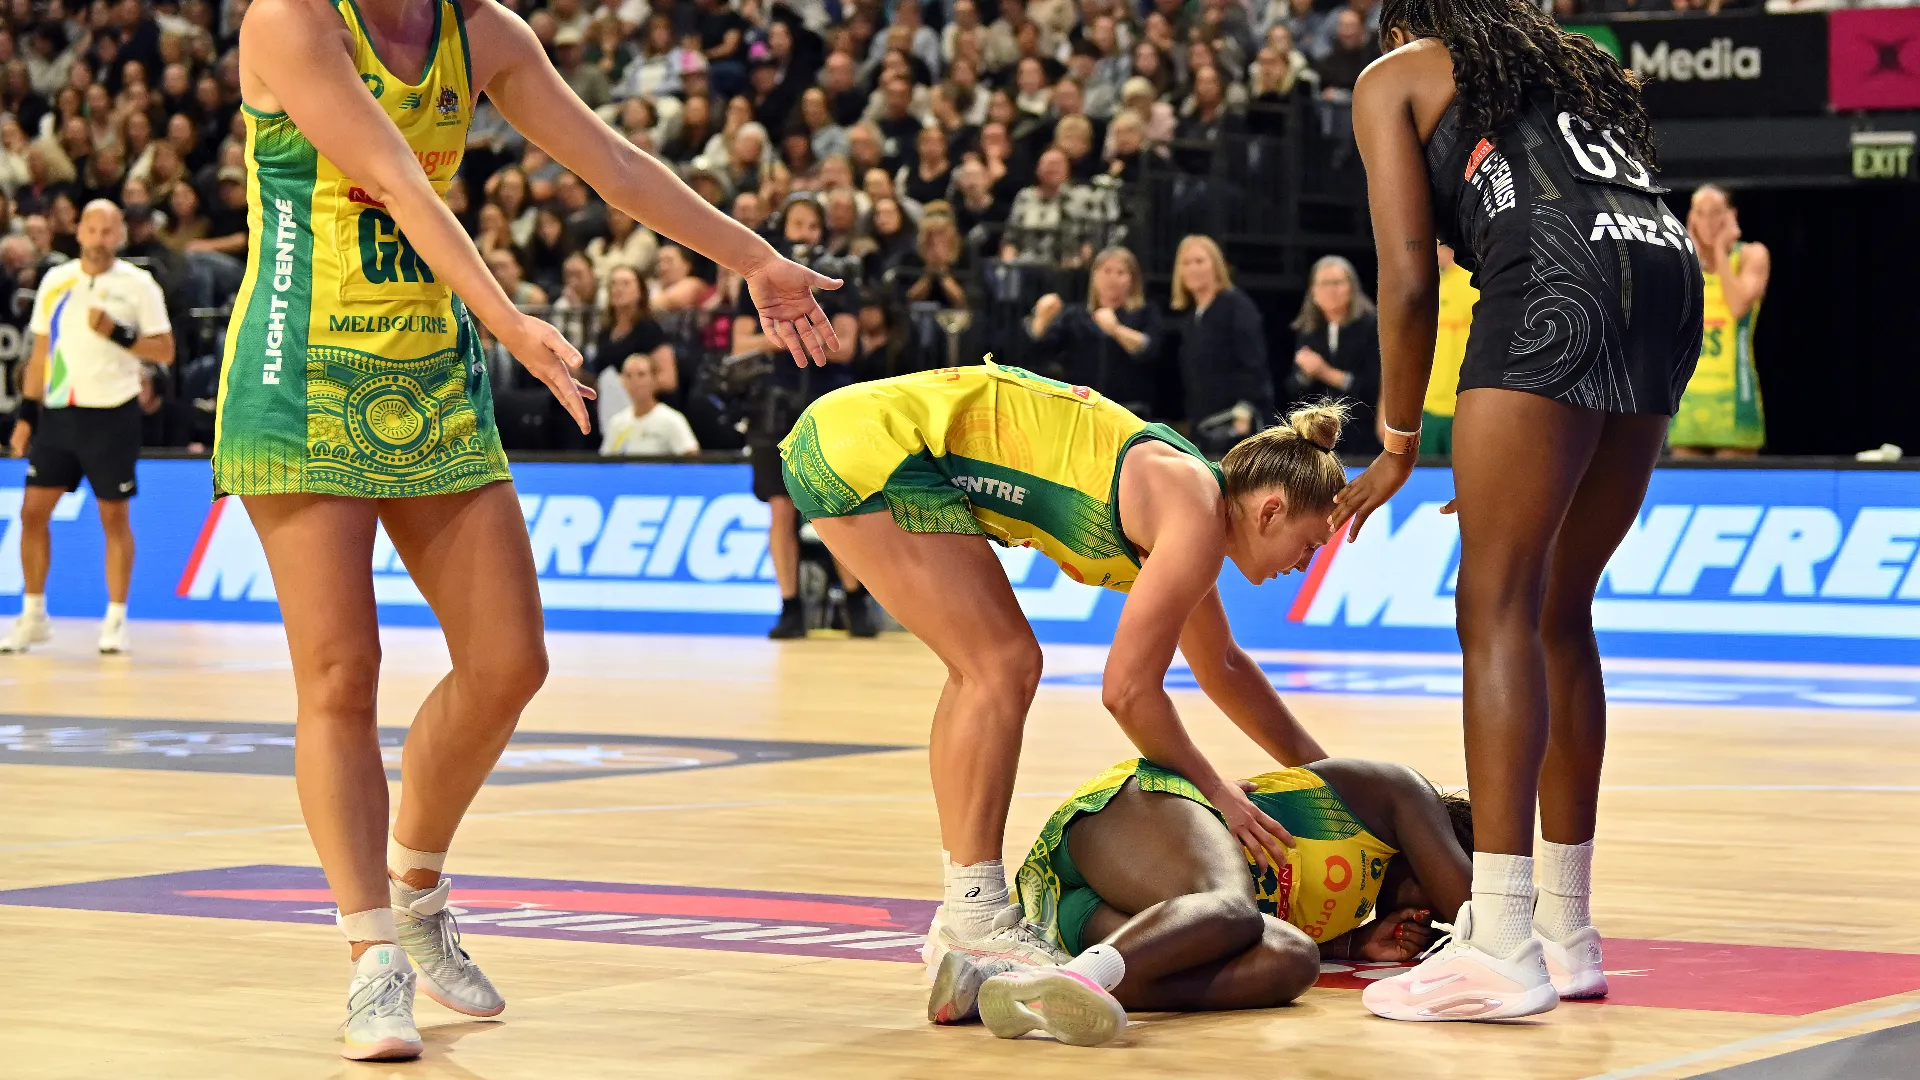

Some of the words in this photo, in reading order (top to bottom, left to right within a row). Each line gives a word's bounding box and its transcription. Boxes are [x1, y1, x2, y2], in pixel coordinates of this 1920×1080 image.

[1631, 37, 1761, 81] Media
[413, 150, 458, 176] igin
[1853, 146, 1911, 178] EXIT
[273, 198, 297, 292] CENTRE
[1590, 212, 1667, 247] ANZ
[263, 295, 289, 385] FLIGHT
[329, 314, 448, 334] MELBOURNE
[1302, 898, 1337, 942] orig
